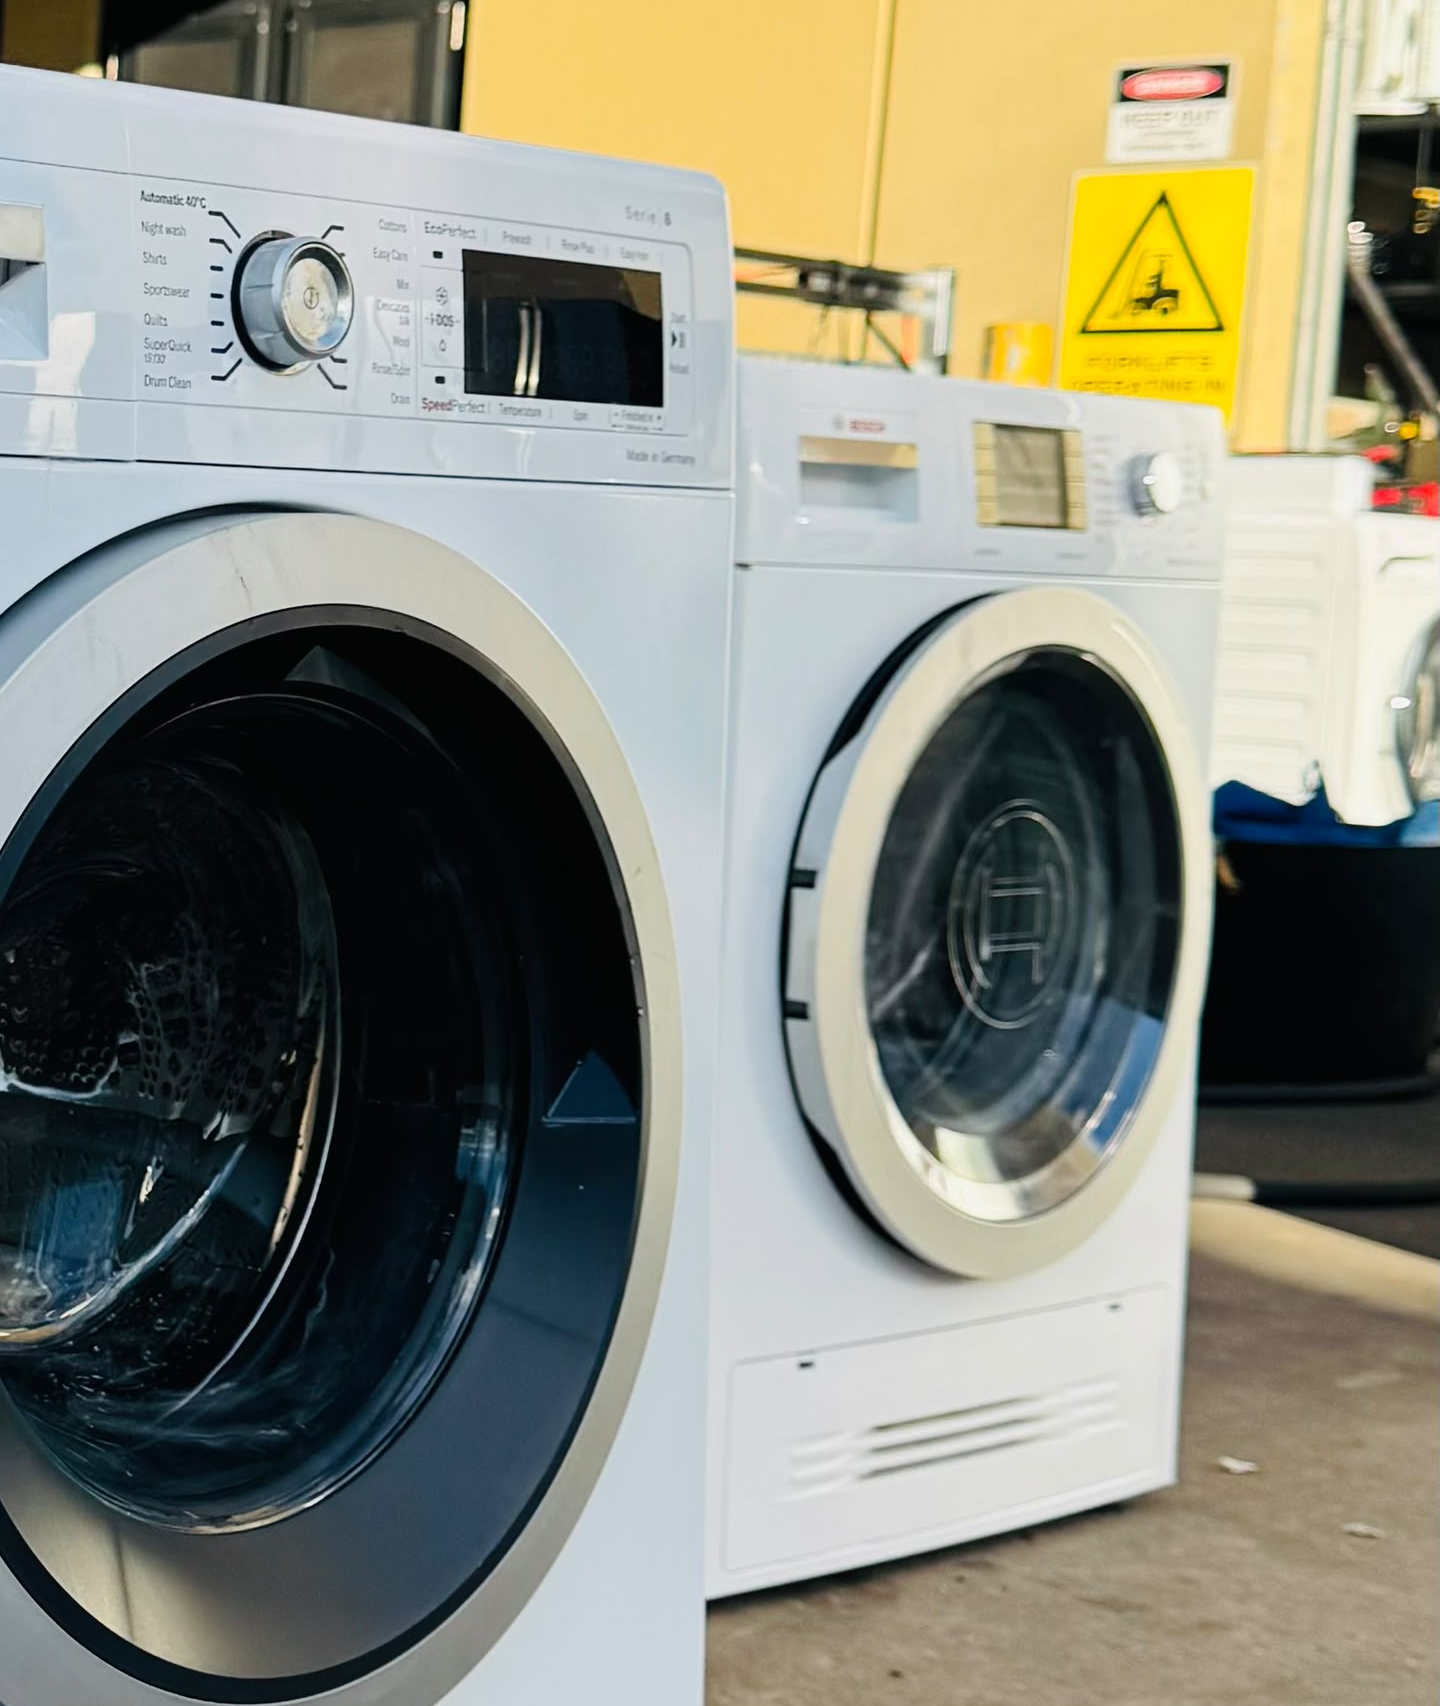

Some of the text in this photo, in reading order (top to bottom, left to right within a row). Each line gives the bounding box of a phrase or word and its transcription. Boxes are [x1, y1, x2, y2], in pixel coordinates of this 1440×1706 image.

[140, 190, 184, 207] Automatic
[141, 221, 187, 237] Night wash
[142, 252, 167, 265] Shirts
[144, 313, 168, 327] Quilts
[144, 338, 192, 353] SuperQuick
[144, 374, 192, 389] Drum Clean
[421, 397, 486, 415] SpeedPerfect
